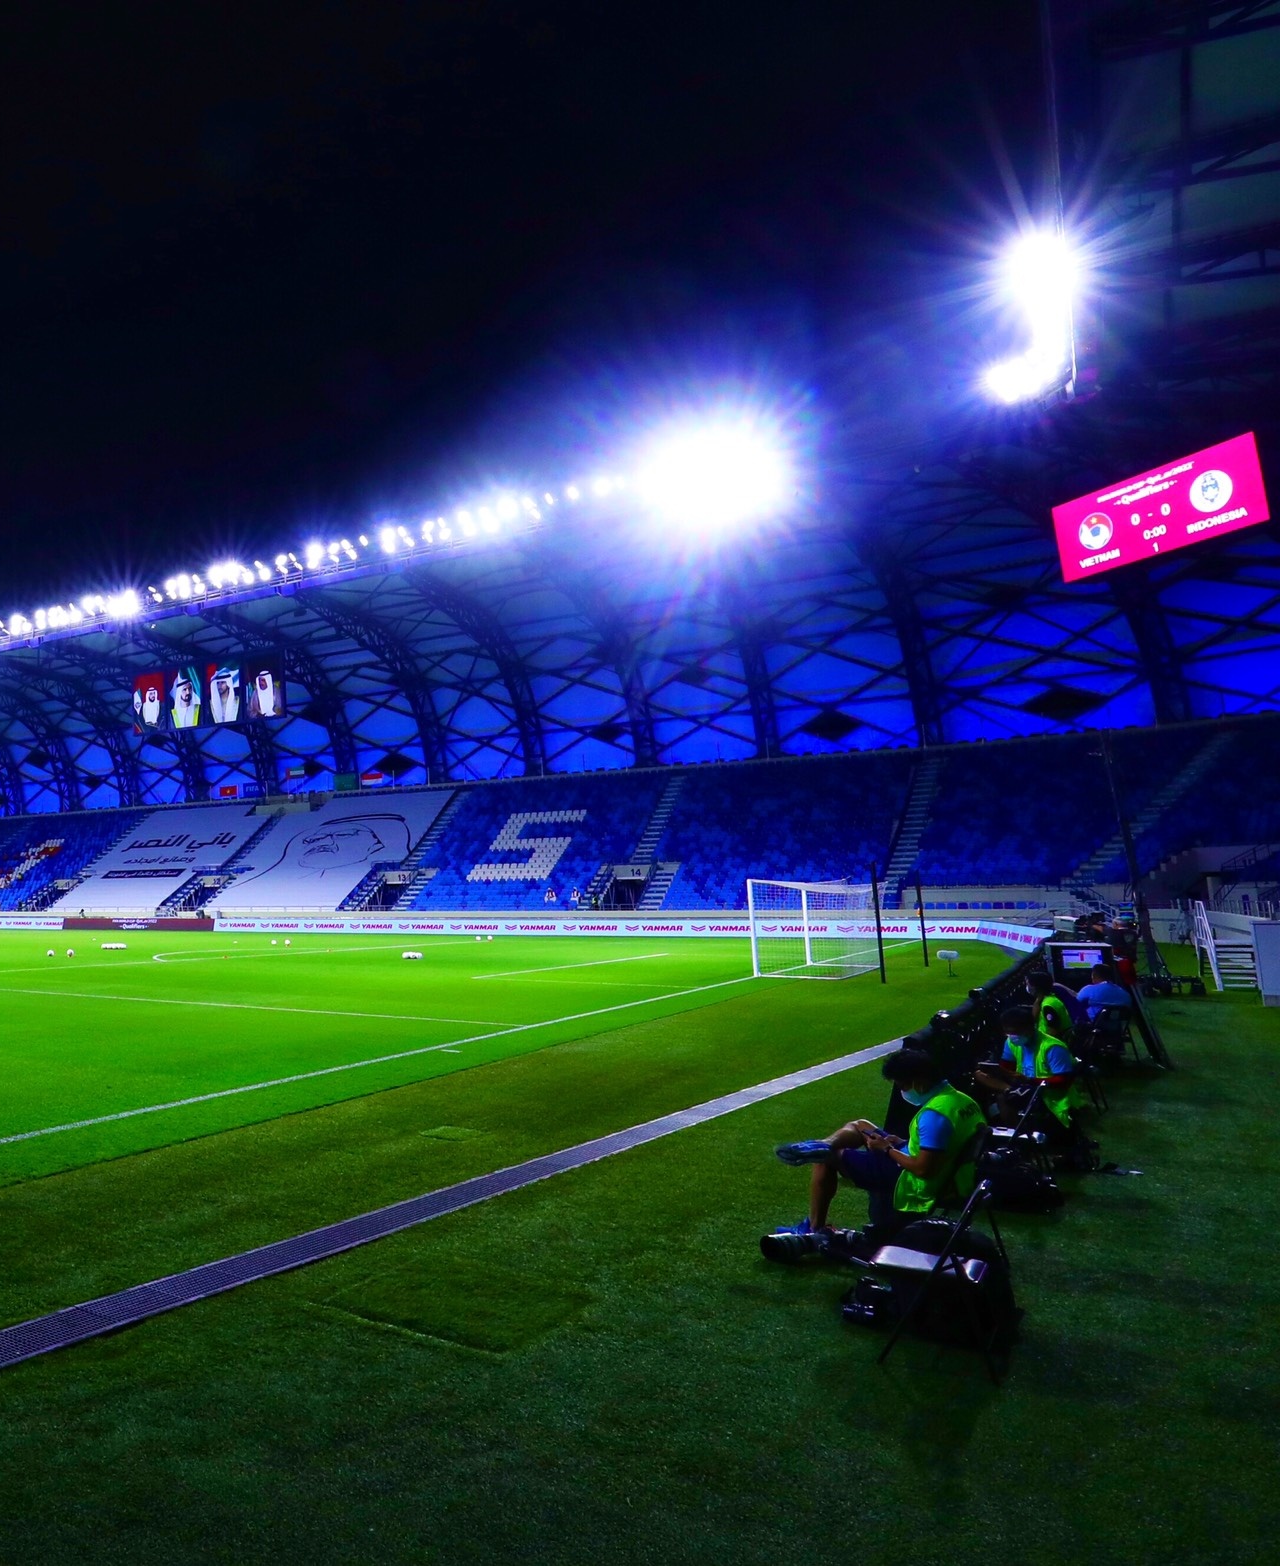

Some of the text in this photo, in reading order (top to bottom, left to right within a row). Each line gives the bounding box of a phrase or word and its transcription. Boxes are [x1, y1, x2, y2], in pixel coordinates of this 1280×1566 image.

[1130, 513, 1140, 526] 0
[1160, 503, 1170, 516] 0
[1186, 507, 1248, 534] INDONESIA
[1143, 525, 1167, 540] 0:00
[1153, 542, 1159, 553] 1
[1079, 548, 1121, 568] VIETNAM
[121, 832, 237, 853] باني النصر
[630, 868, 642, 877] 14
